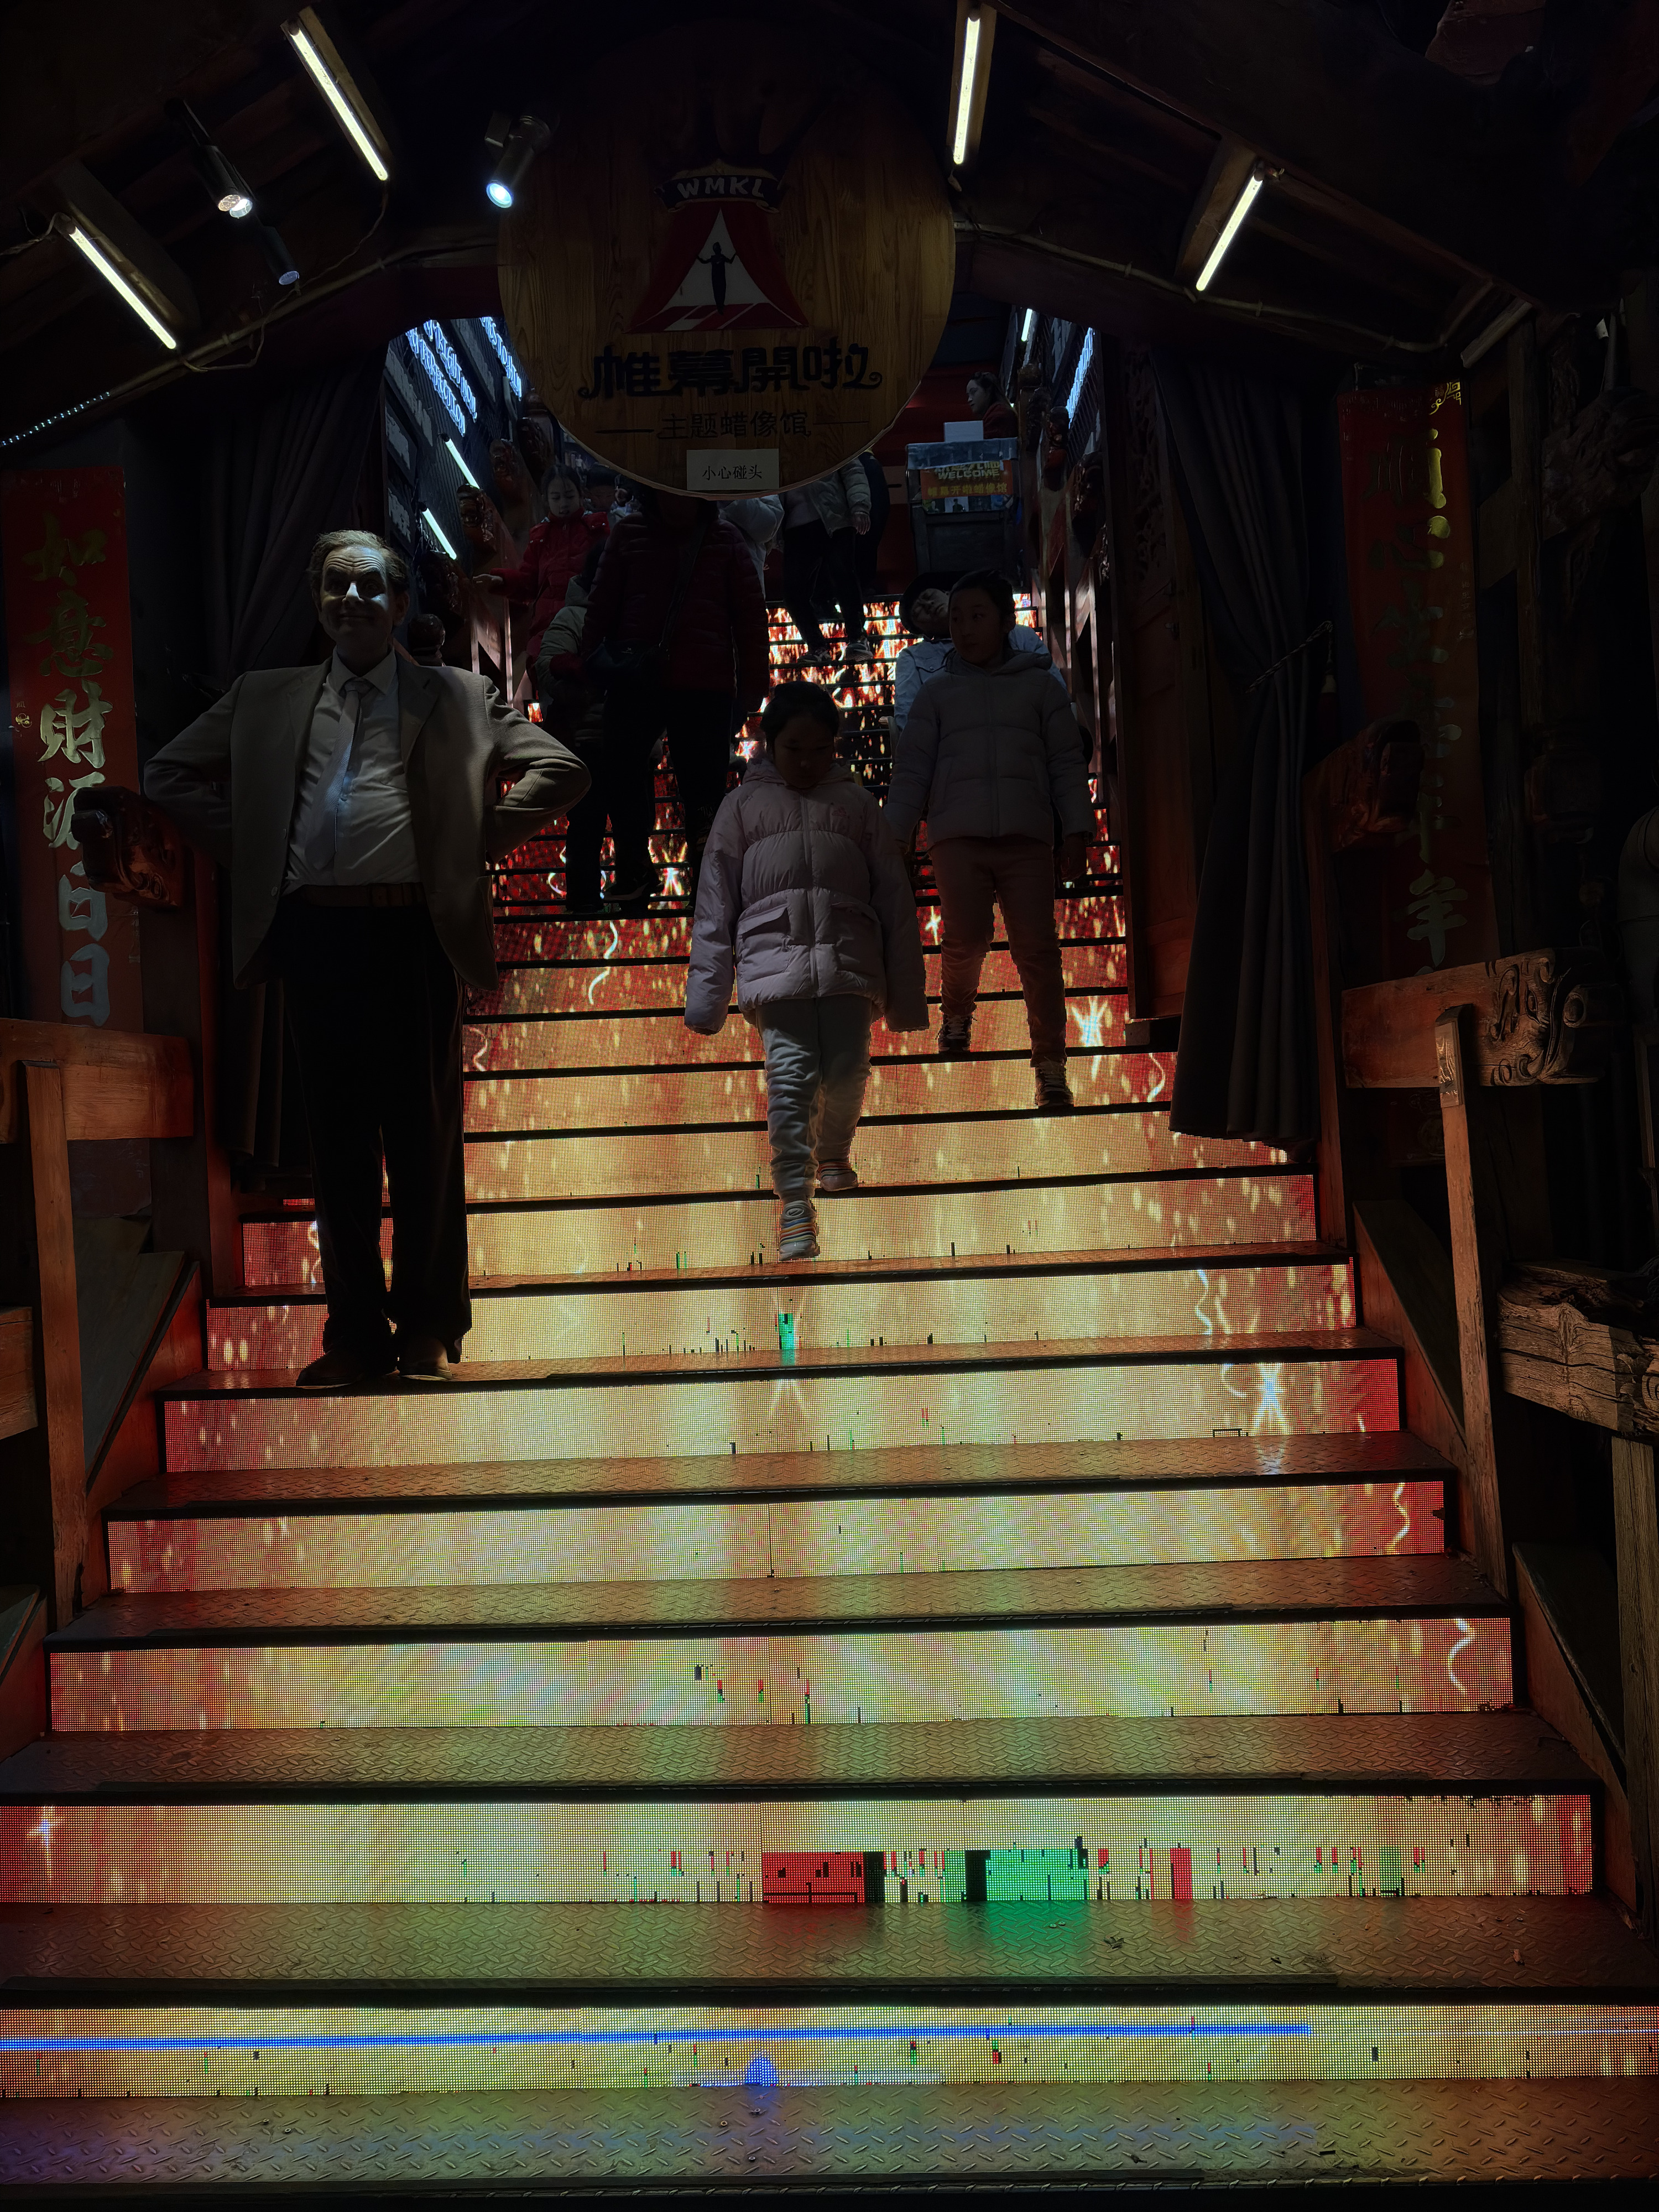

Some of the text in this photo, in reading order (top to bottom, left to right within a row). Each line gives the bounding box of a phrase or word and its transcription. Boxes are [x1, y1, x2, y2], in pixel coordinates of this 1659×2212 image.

[676, 176, 764, 199] WMKL
[656, 409, 811, 440] 主题蜡像馆
[702, 465, 762, 481] 小心碰头
[938, 469, 1000, 480] WELCOME
